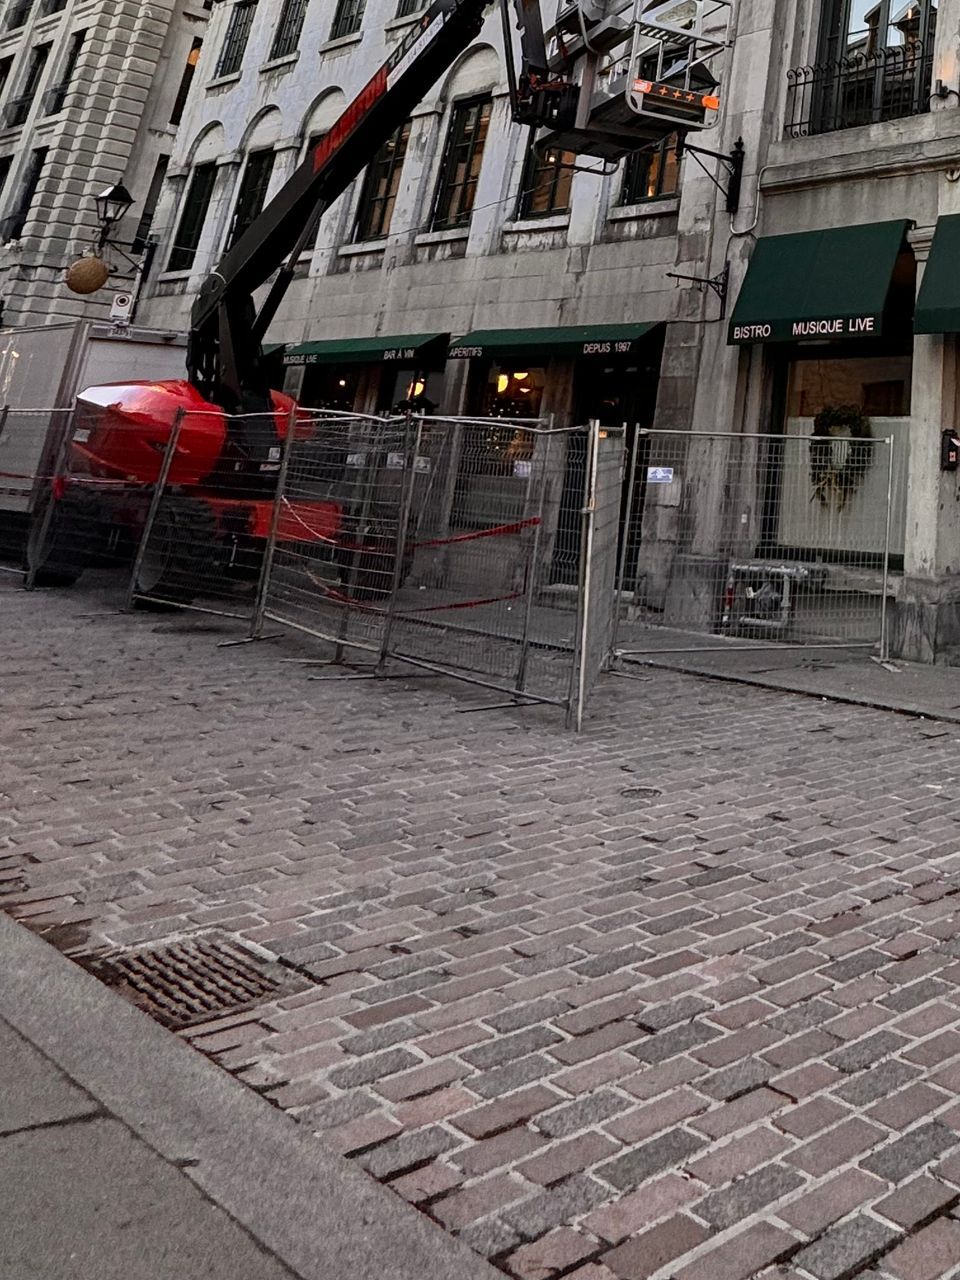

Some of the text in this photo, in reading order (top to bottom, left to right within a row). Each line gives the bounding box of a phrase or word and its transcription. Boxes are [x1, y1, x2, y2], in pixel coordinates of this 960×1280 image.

[733, 317, 874, 339] BISTRO MUSIQUE LIVE
[383, 350, 396, 360] BAR
[583, 342, 611, 355] DEPUIS
